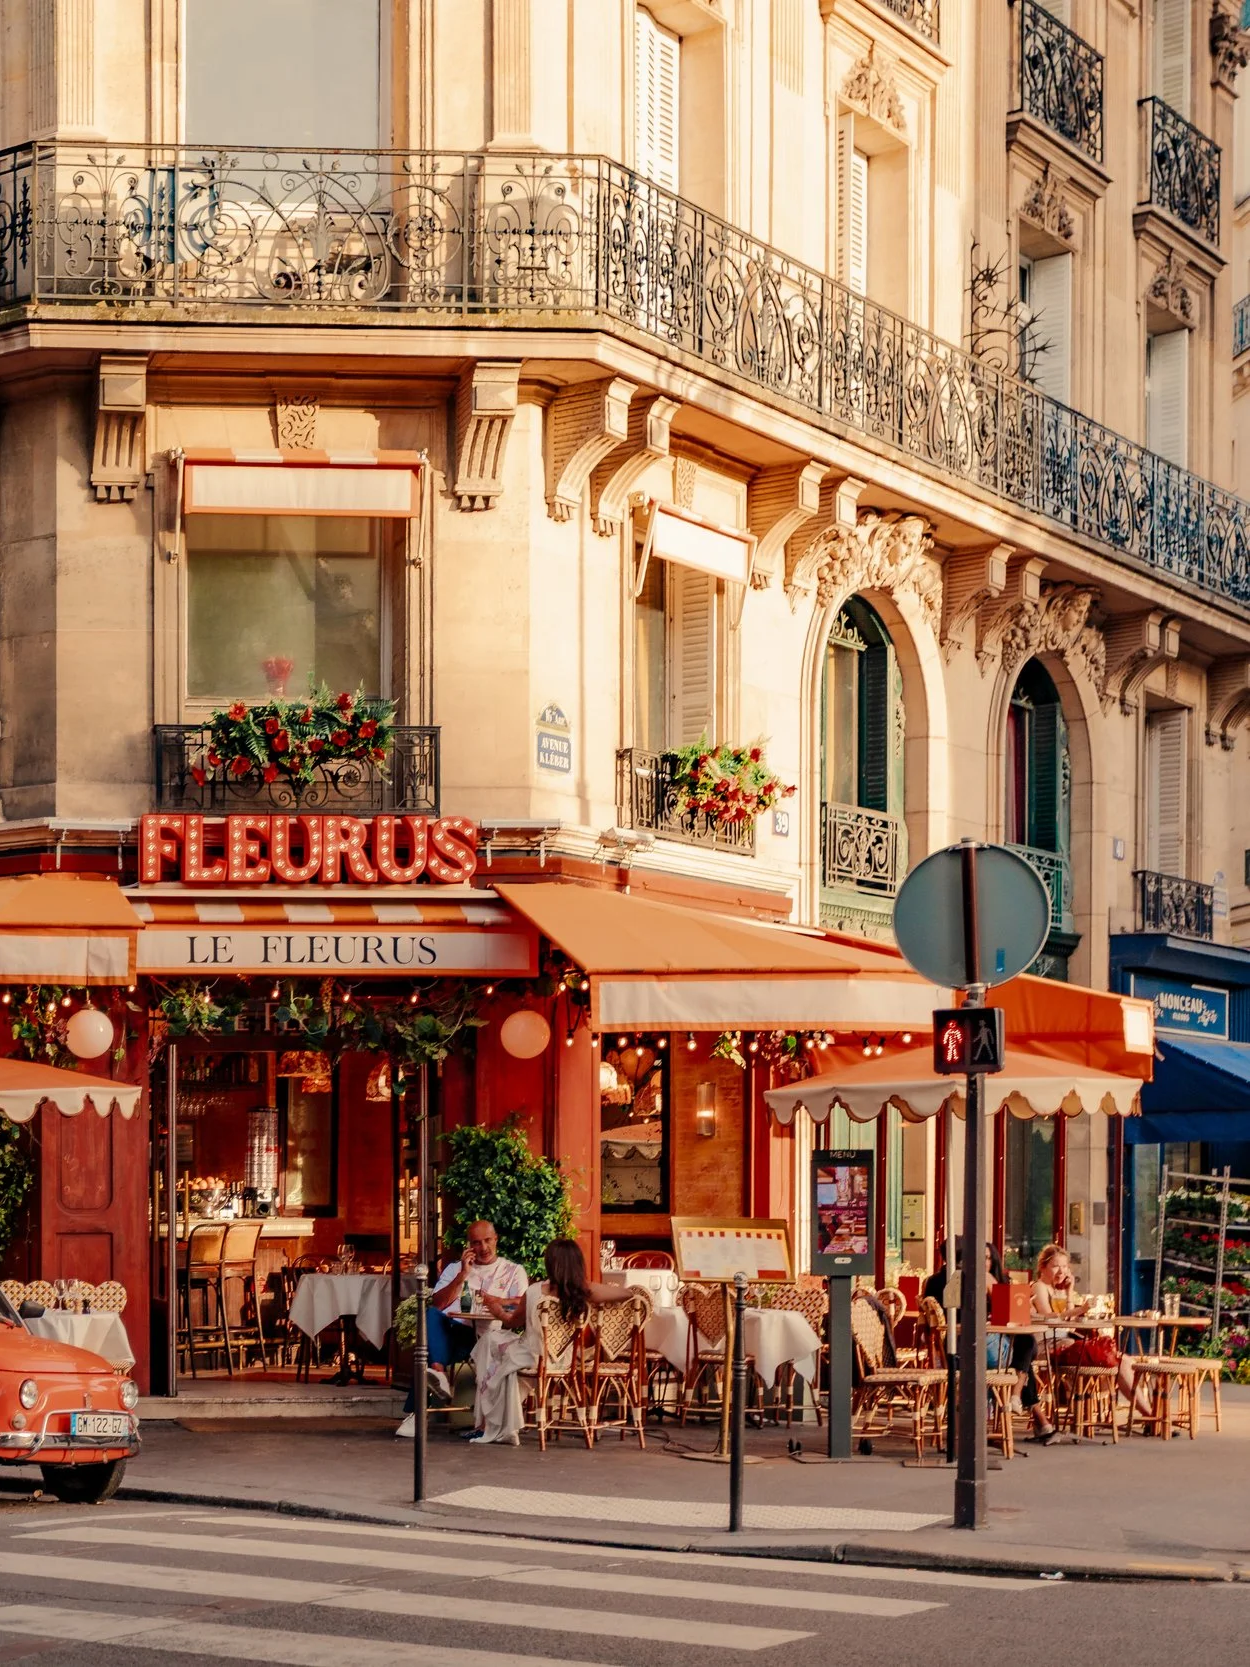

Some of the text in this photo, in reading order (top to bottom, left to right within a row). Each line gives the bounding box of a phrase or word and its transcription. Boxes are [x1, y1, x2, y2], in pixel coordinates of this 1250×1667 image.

[541, 737, 569, 754] AVENUE
[539, 751, 569, 769] KLÉBER
[775, 811, 789, 834] 39
[141, 814, 477, 883] FLEURUS
[186, 935, 438, 965] LE FLEURUS
[1161, 992, 1203, 1014] MONCEAU
[830, 1150, 857, 1159] MENU
